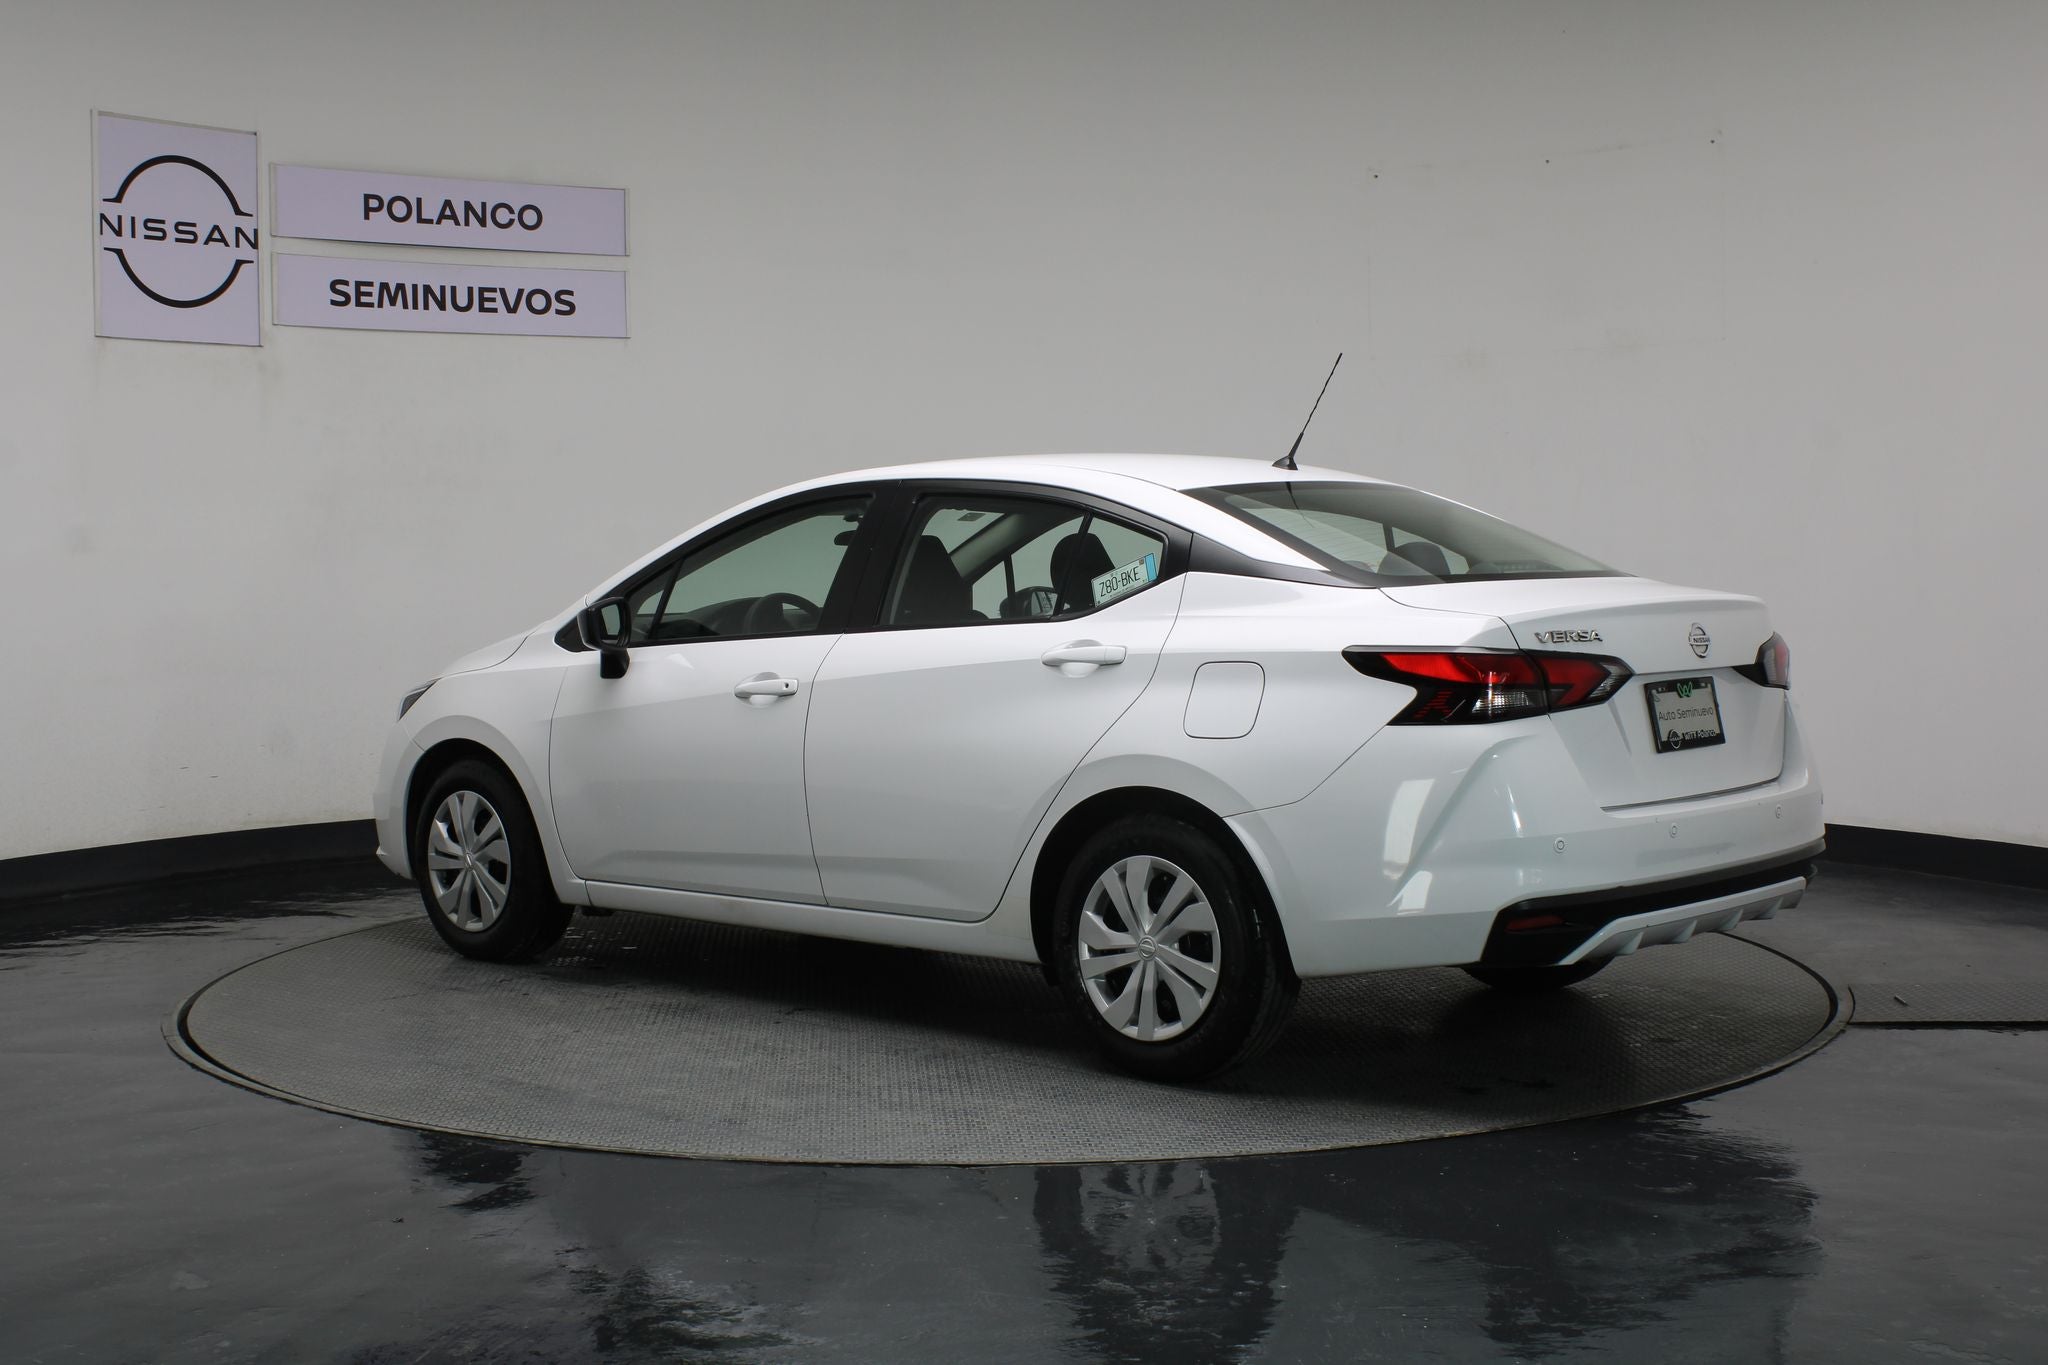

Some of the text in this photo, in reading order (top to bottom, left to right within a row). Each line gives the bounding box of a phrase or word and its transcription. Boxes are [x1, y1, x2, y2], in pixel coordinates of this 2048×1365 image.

[362, 193, 544, 232] POLANCO
[100, 212, 259, 250] NISSAN
[329, 278, 577, 316] SEMINUEVOS
[1098, 565, 1141, 597] Z80-BKE
[1534, 629, 1603, 643] VERSA
[1658, 706, 1714, 721] Auto Seminuevo
